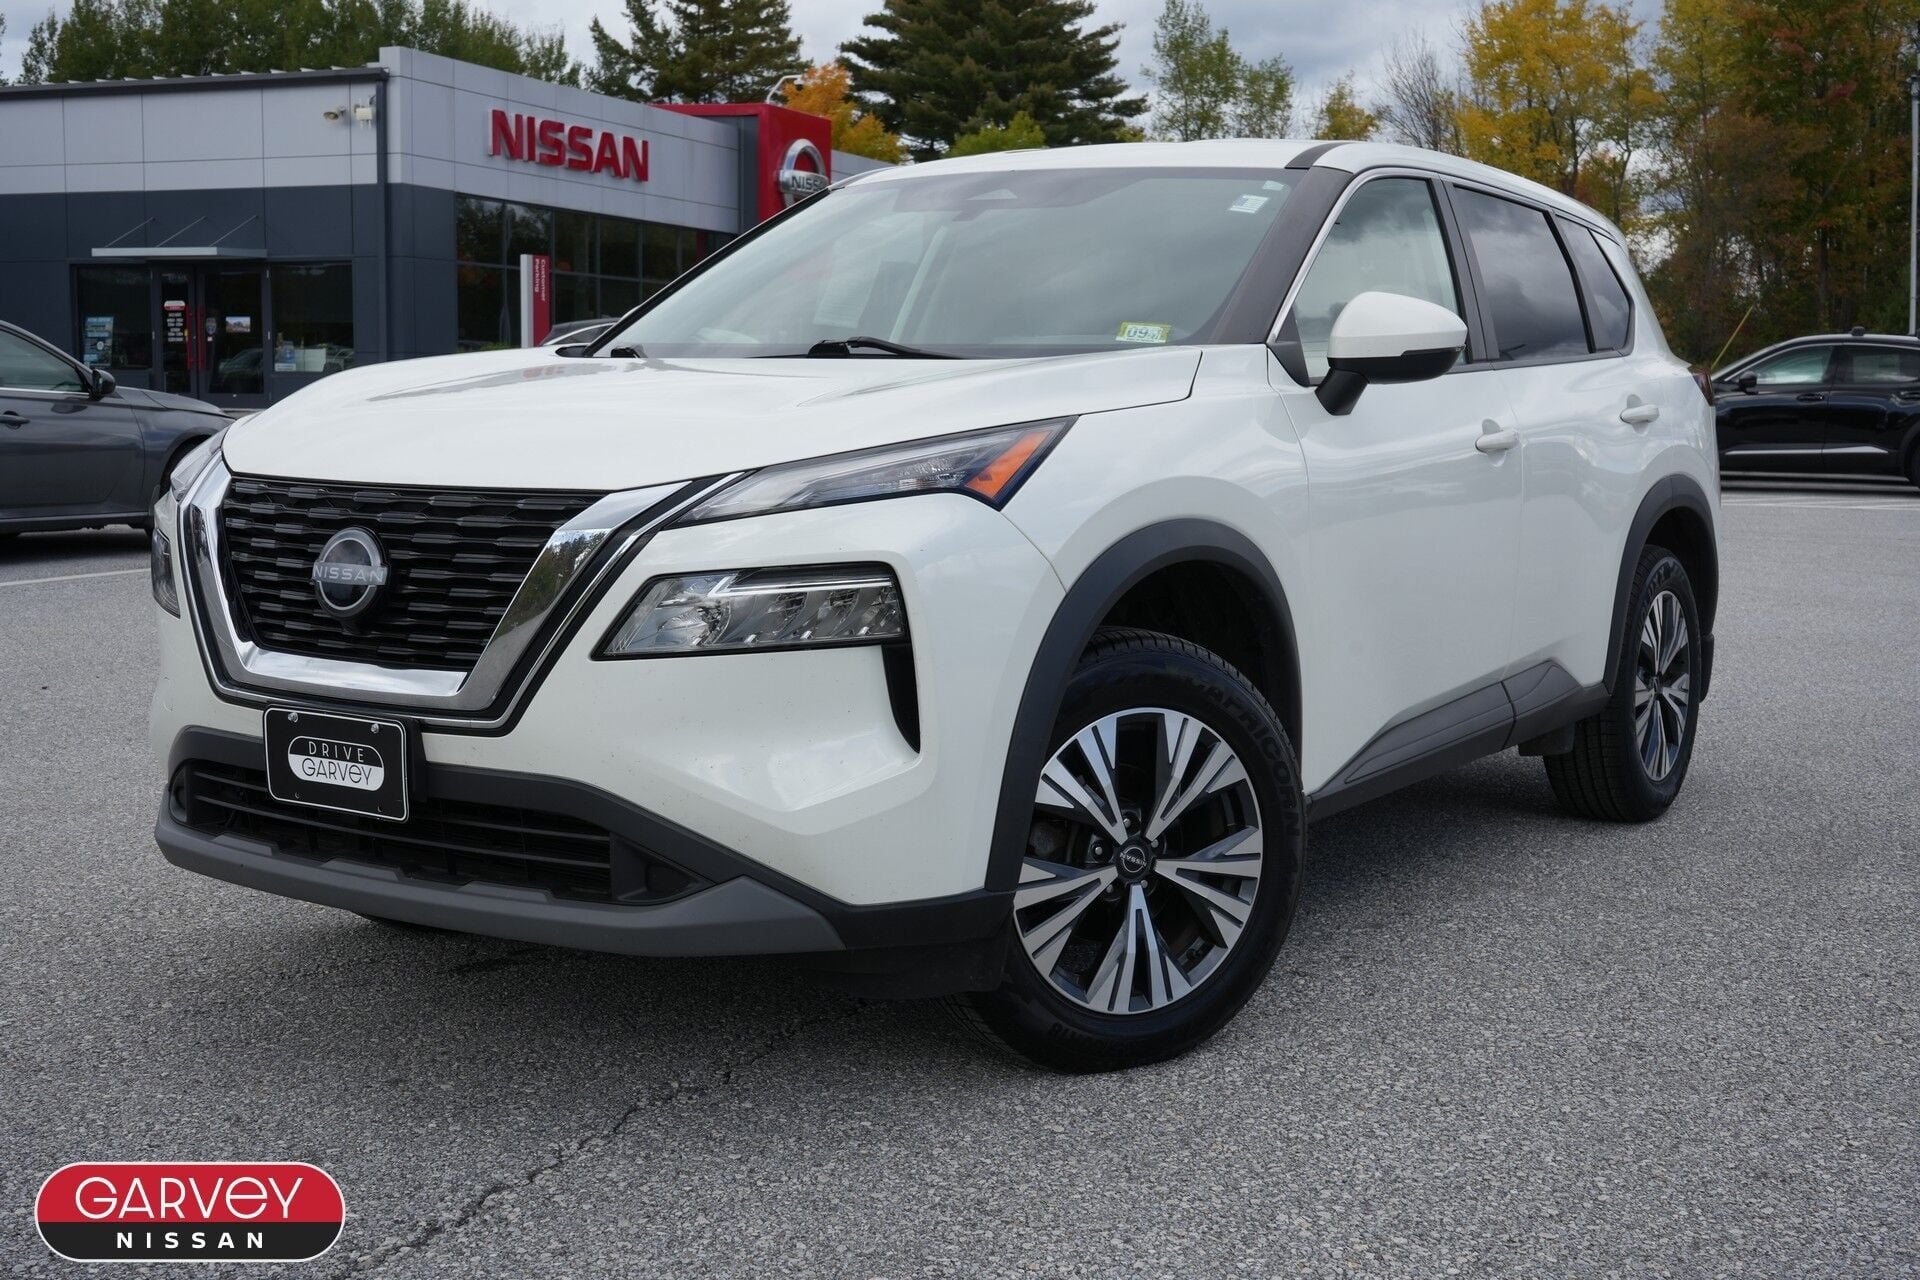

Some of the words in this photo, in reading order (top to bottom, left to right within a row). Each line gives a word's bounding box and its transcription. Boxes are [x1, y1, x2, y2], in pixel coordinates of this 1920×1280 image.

[490, 109, 649, 182] NISSAN
[791, 175, 822, 191] NISS
[312, 564, 385, 583] NISSAN
[308, 741, 365, 763] DRIVE
